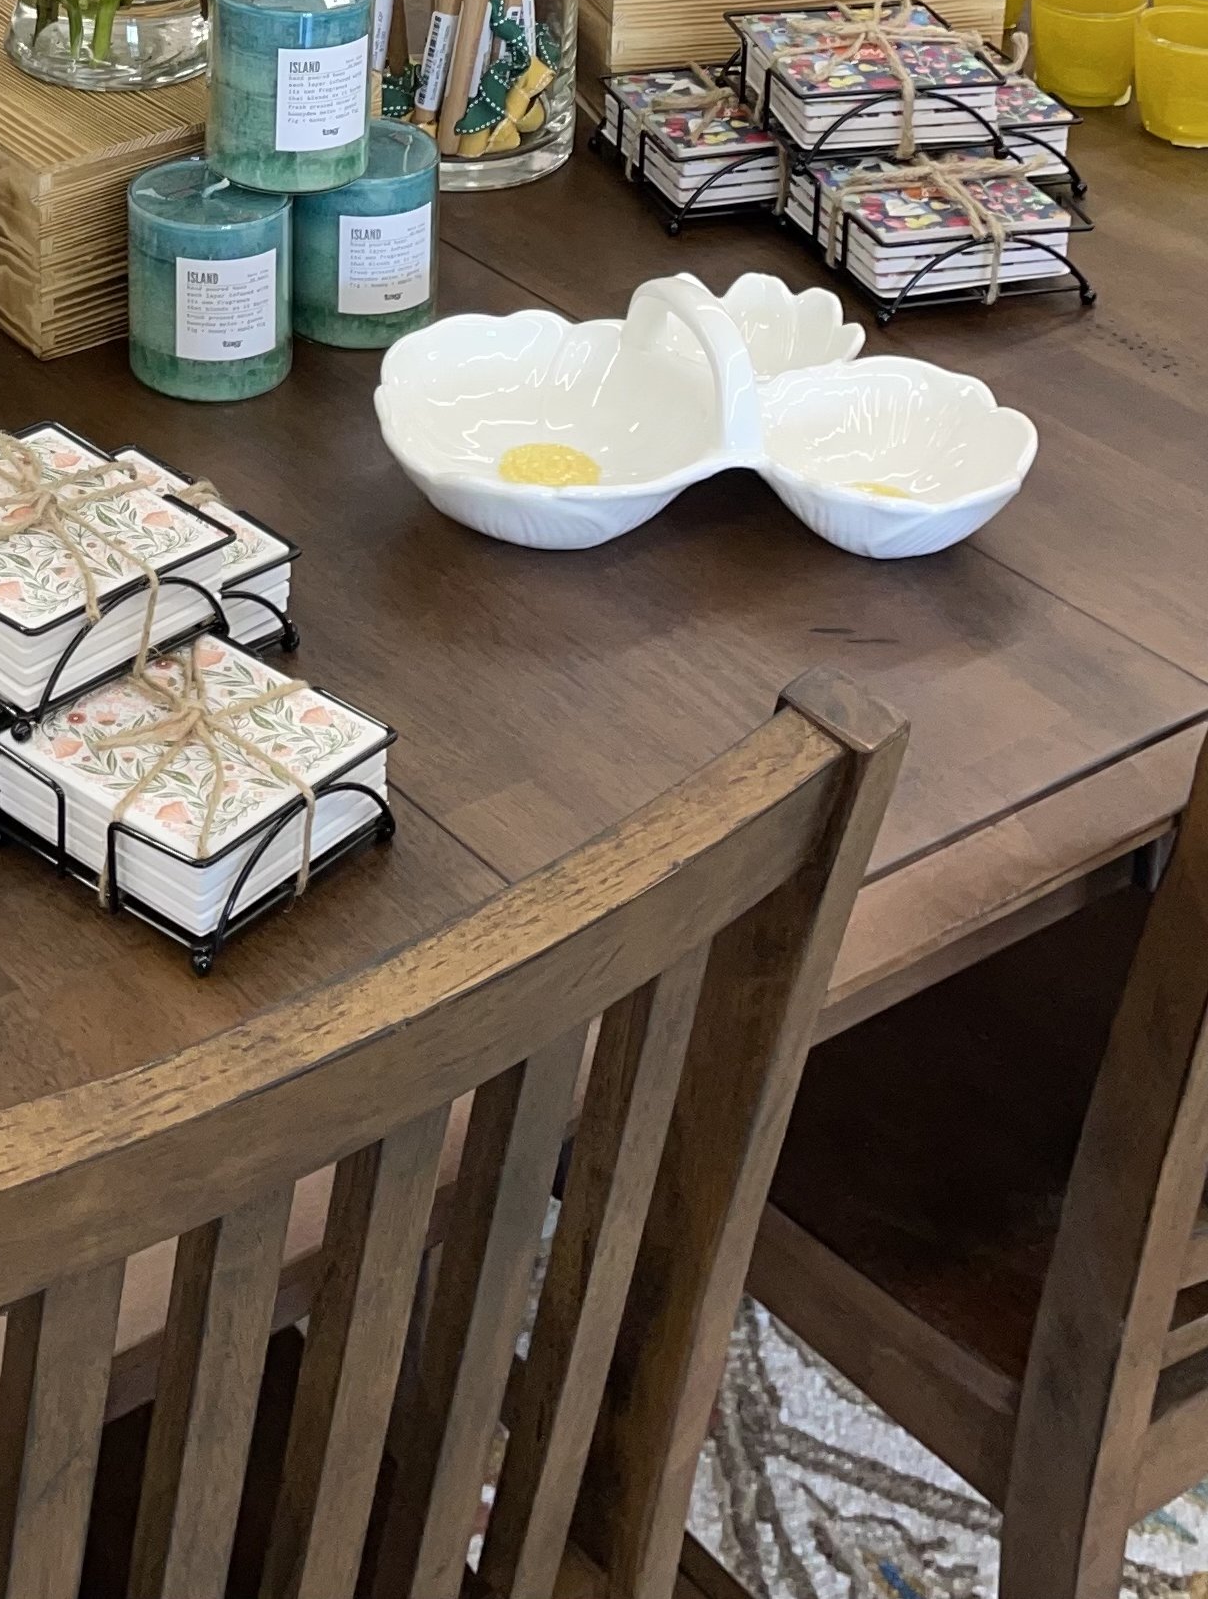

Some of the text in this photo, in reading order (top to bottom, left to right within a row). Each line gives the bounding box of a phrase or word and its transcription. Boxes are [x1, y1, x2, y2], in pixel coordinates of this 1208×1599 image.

[289, 61, 320, 73] ISLAND
[351, 229, 382, 240] ISLAND
[187, 271, 219, 284] ISLAND
